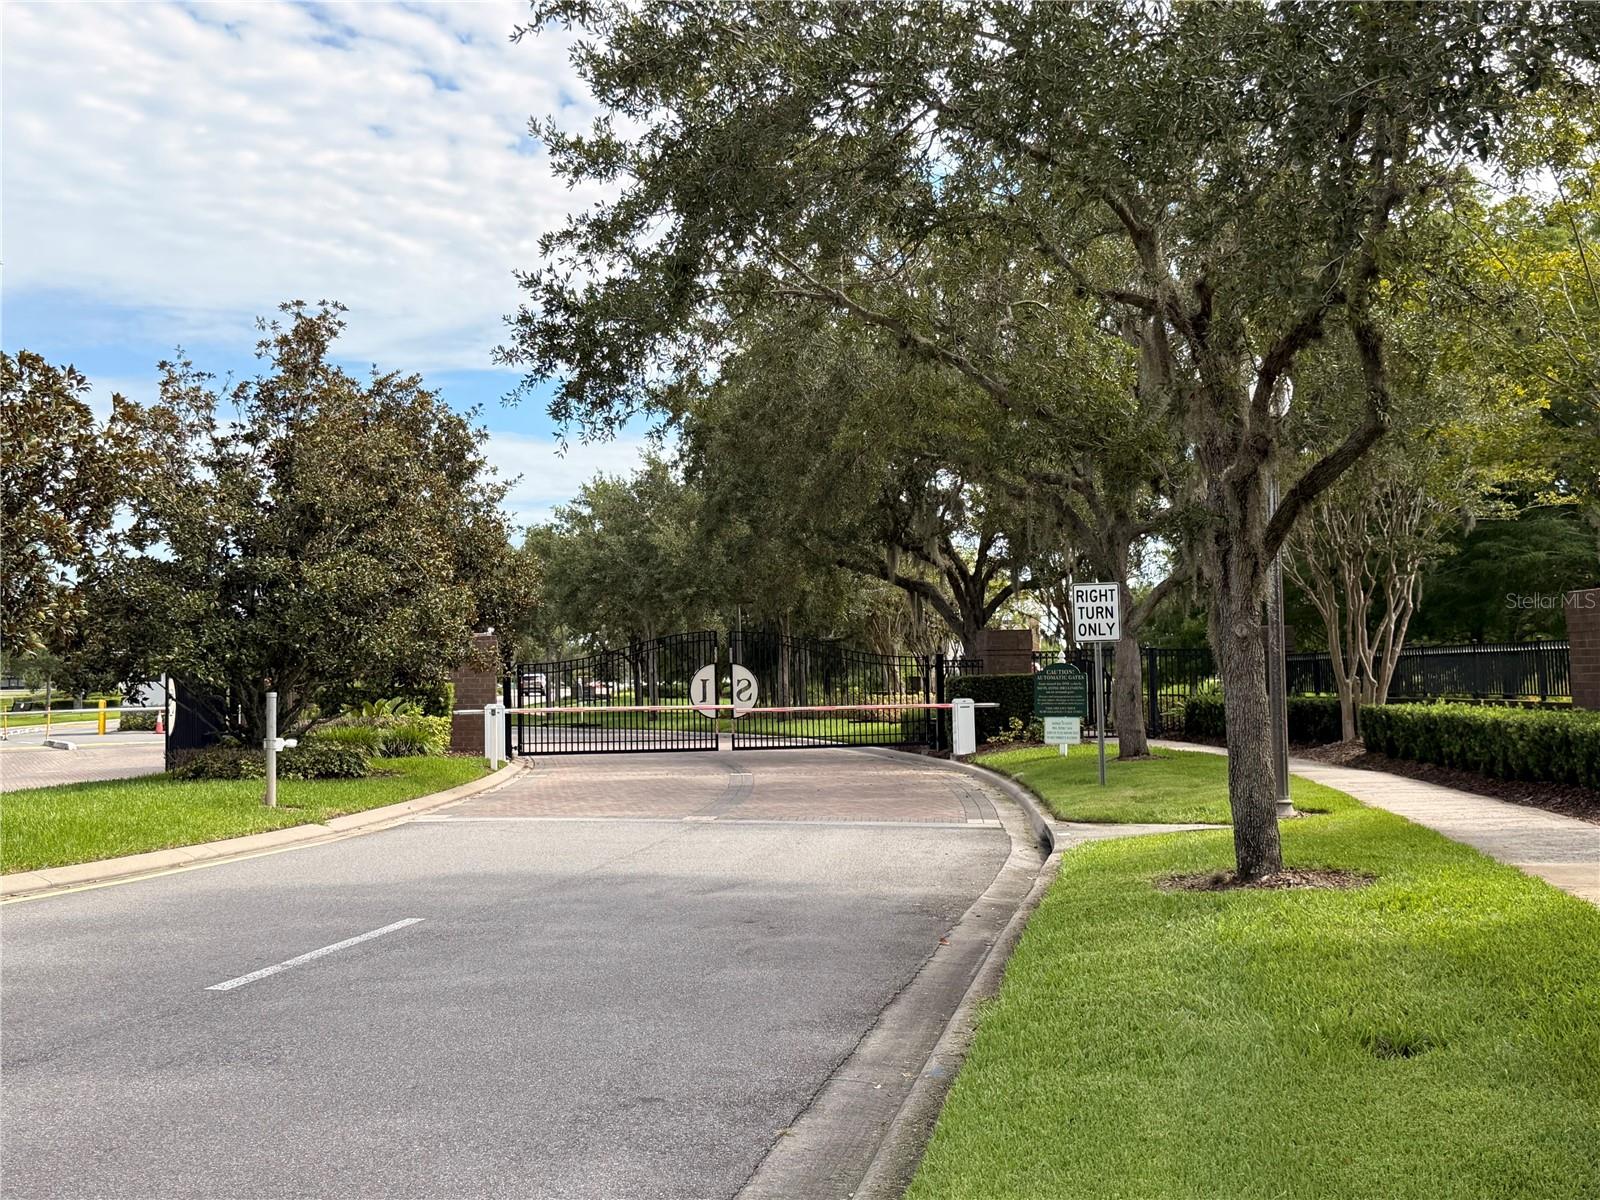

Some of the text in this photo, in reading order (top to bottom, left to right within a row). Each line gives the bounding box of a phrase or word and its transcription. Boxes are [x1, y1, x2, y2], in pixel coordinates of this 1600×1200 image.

[1076, 589, 1116, 603] RIGHT
[1078, 606, 1114, 620] TURN
[1078, 622, 1116, 637] ONLY
